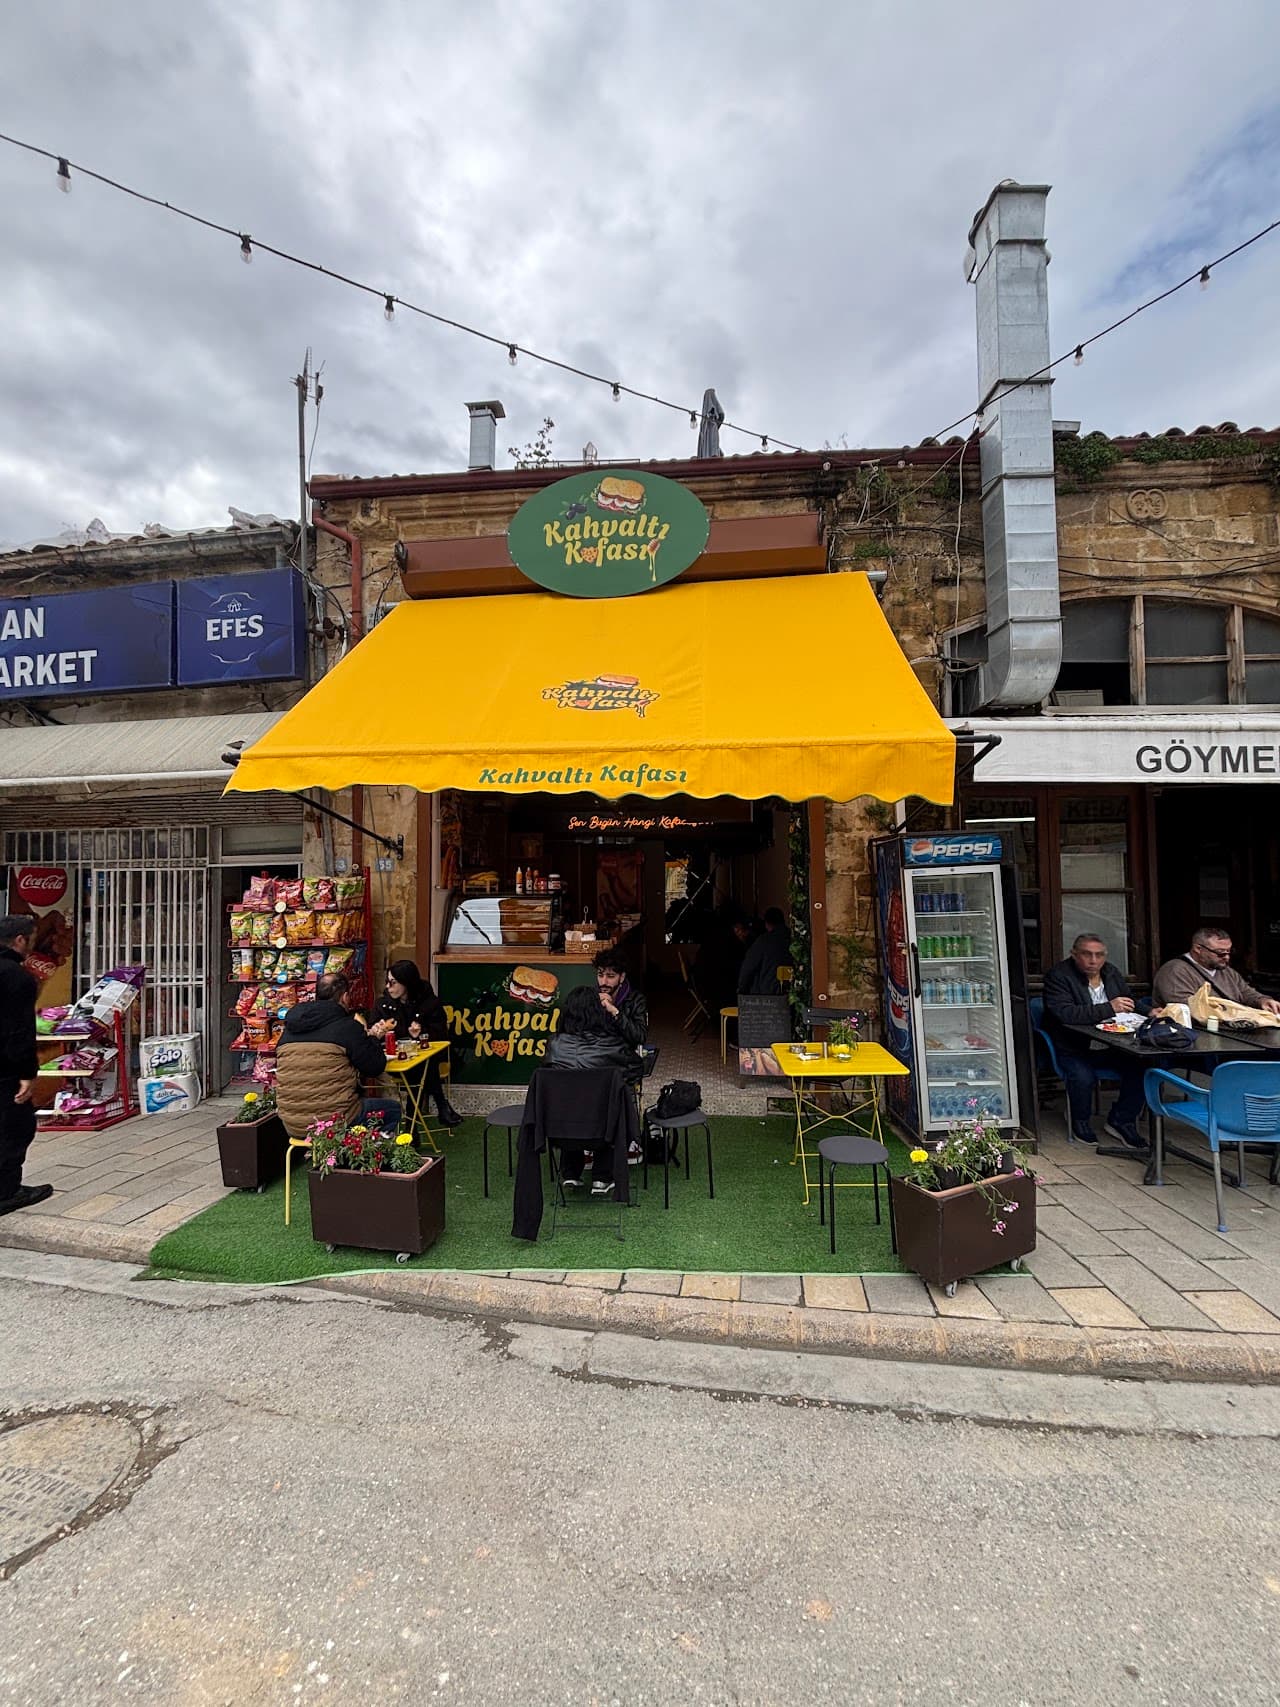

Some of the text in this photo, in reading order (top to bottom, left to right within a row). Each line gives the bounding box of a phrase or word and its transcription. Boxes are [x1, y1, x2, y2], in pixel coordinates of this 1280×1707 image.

[543, 514, 670, 548] Kahvaltı
[564, 537, 651, 567] Kfası
[0, 607, 45, 641] AN
[206, 614, 264, 641] EFES
[558, 696, 640, 710] Kfası
[1136, 739, 1280, 773] GÖYME
[479, 763, 687, 788] Kahvaltı Kafası
[568, 816, 588, 830] Sen
[588, 815, 621, 831] Bugün
[623, 816, 656, 830] Hangi
[932, 842, 993, 858] PEPSI
[452, 1005, 561, 1036] Kahval
